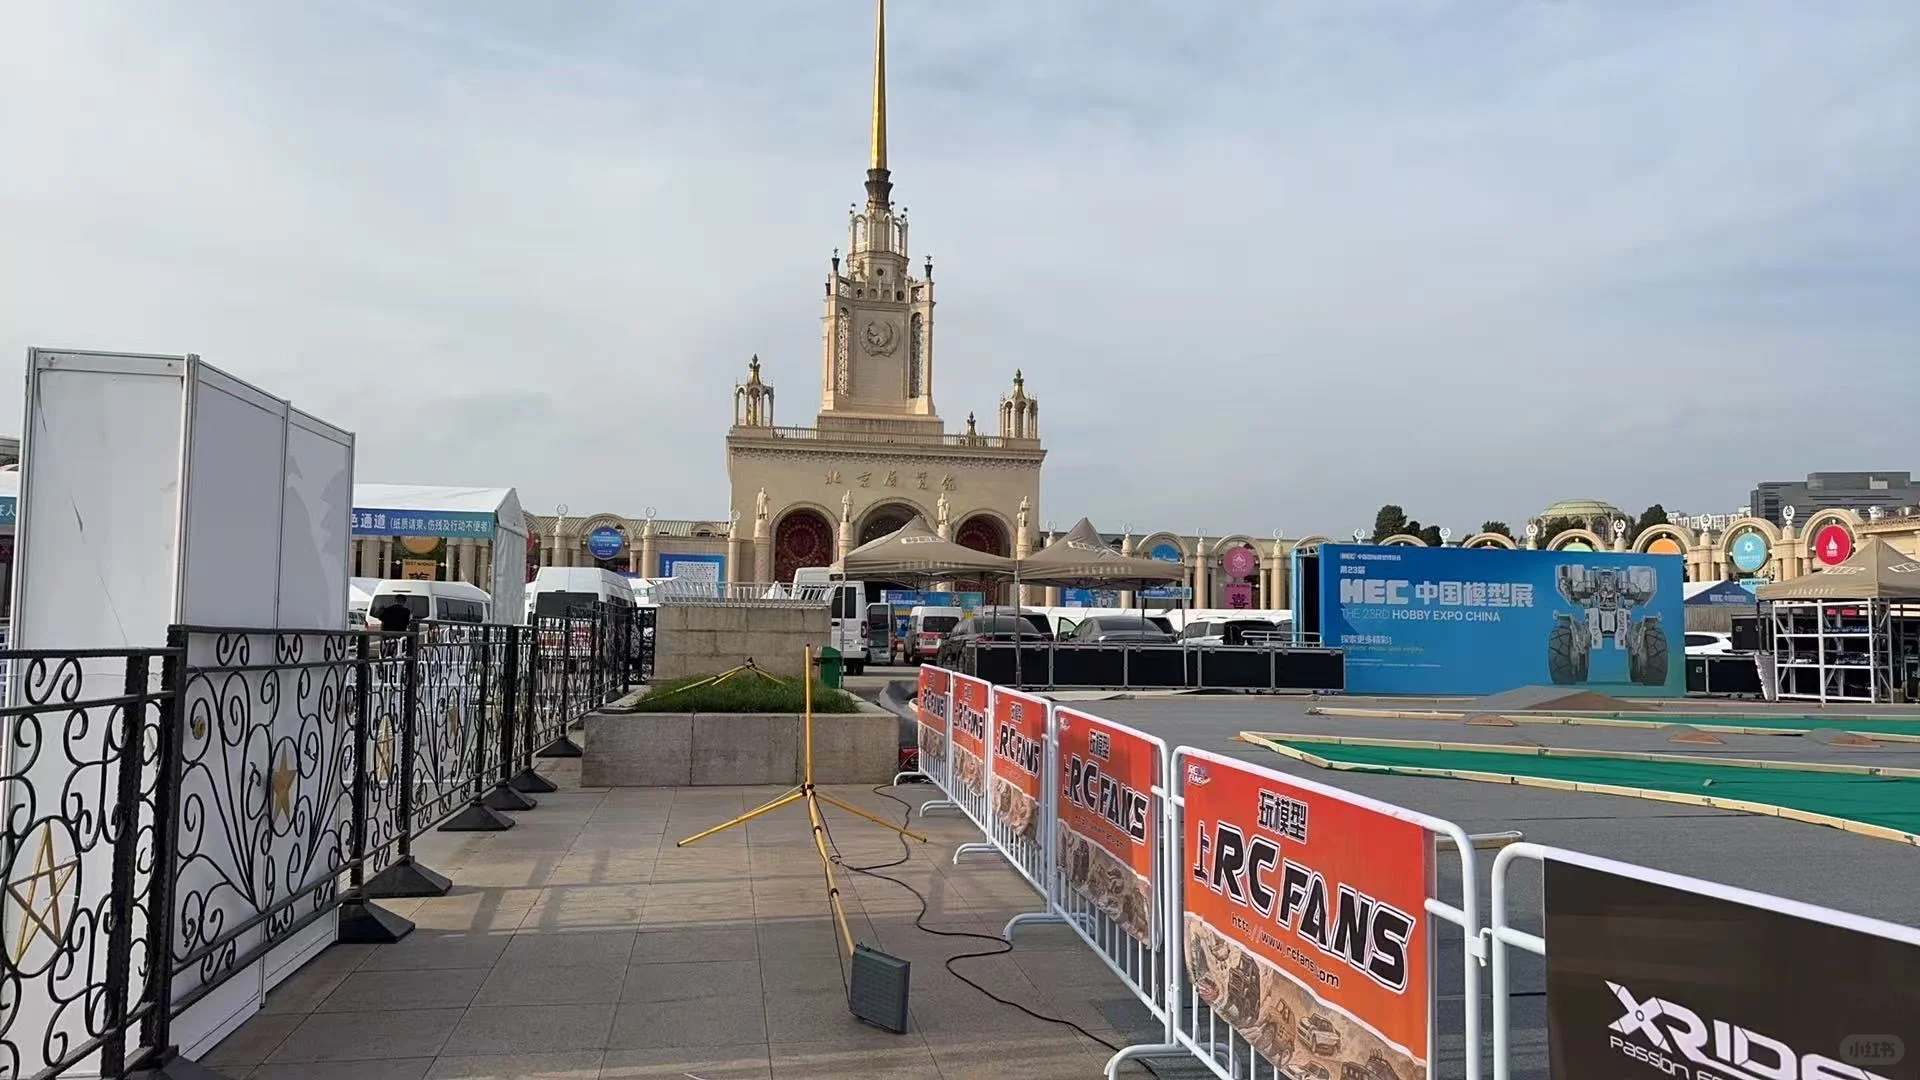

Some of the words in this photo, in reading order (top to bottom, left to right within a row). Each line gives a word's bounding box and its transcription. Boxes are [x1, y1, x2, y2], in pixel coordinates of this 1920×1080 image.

[1416, 581, 1533, 607] 中国模型展
[1341, 608, 1361, 619] THE
[1392, 609, 1430, 621] HOBBY
[1433, 610, 1463, 621] EXPO
[1465, 611, 1501, 622] CHINA
[1258, 788, 1309, 844] 玩模型
[1610, 1035, 1691, 1080] Passion
